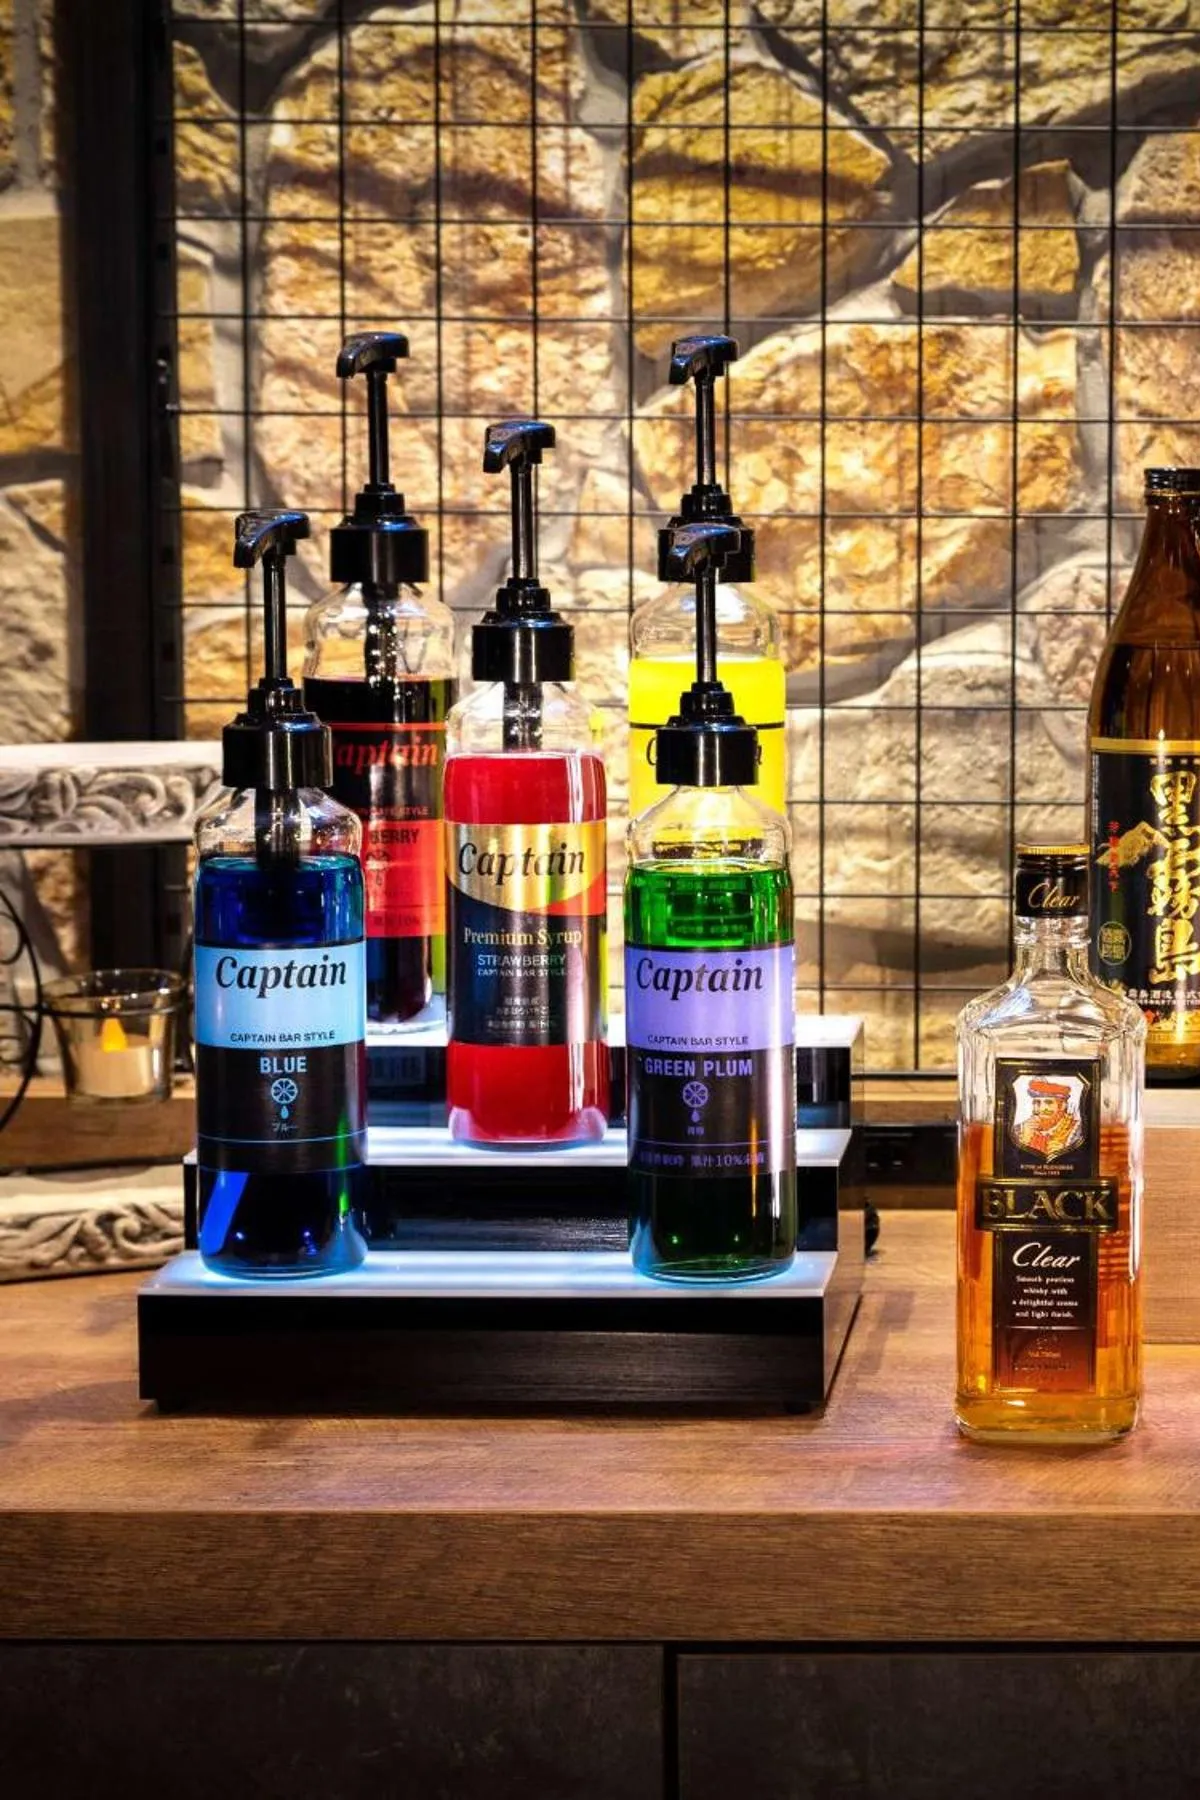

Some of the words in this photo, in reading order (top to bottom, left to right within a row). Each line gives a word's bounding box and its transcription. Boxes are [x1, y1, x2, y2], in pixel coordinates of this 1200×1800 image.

[334, 735, 438, 774] aptain
[459, 842, 585, 886] Captain
[1028, 882, 1080, 908] Clear
[464, 927, 534, 946] Premium
[537, 928, 582, 950] Syrup
[478, 954, 566, 967] STRAWBERRY
[215, 954, 346, 999] Captain
[636, 957, 763, 1001] Captain
[230, 1032, 276, 1043] CAPTAIN
[278, 1033, 301, 1042] BAR
[304, 1029, 336, 1042] STYLE
[648, 1035, 688, 1047] CAPTAIN
[691, 1036, 713, 1047] BAR
[715, 1035, 749, 1047] STYLE
[260, 1055, 308, 1074] BLUE
[645, 1057, 696, 1077] GREEN
[703, 1059, 753, 1077] PLUM
[982, 1187, 1116, 1223] BLACK
[1012, 1242, 1082, 1269] Clear
